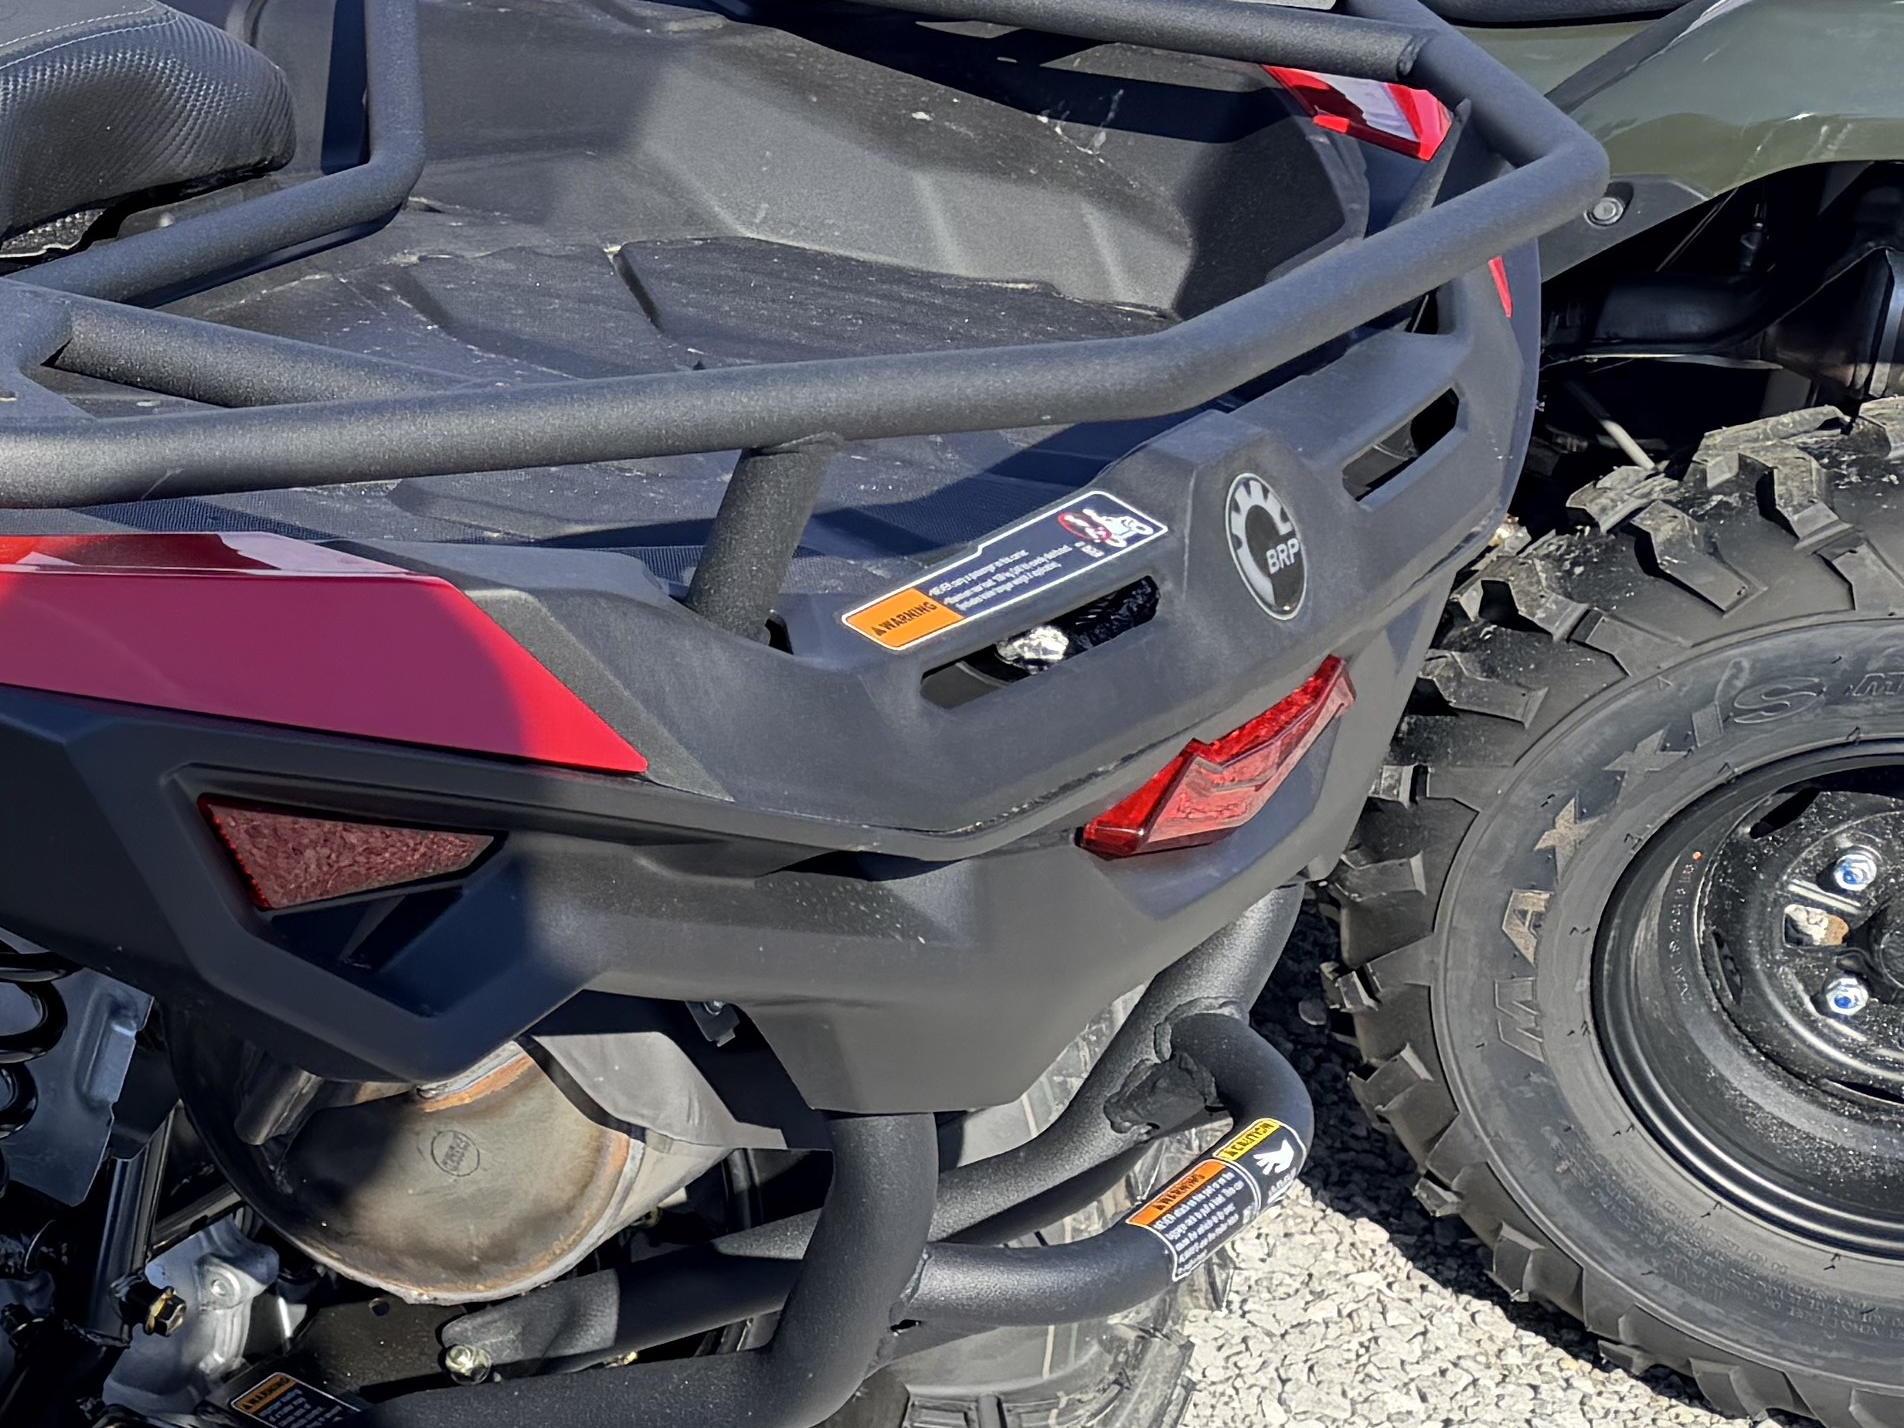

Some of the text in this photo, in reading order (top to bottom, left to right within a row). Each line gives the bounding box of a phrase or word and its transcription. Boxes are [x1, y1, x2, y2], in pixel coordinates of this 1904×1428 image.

[1266, 538, 1300, 574] BRP
[883, 601, 937, 631] WARNING
[1494, 657, 1827, 1062] MAXXIS
[1161, 1174, 1205, 1208] WARNING
